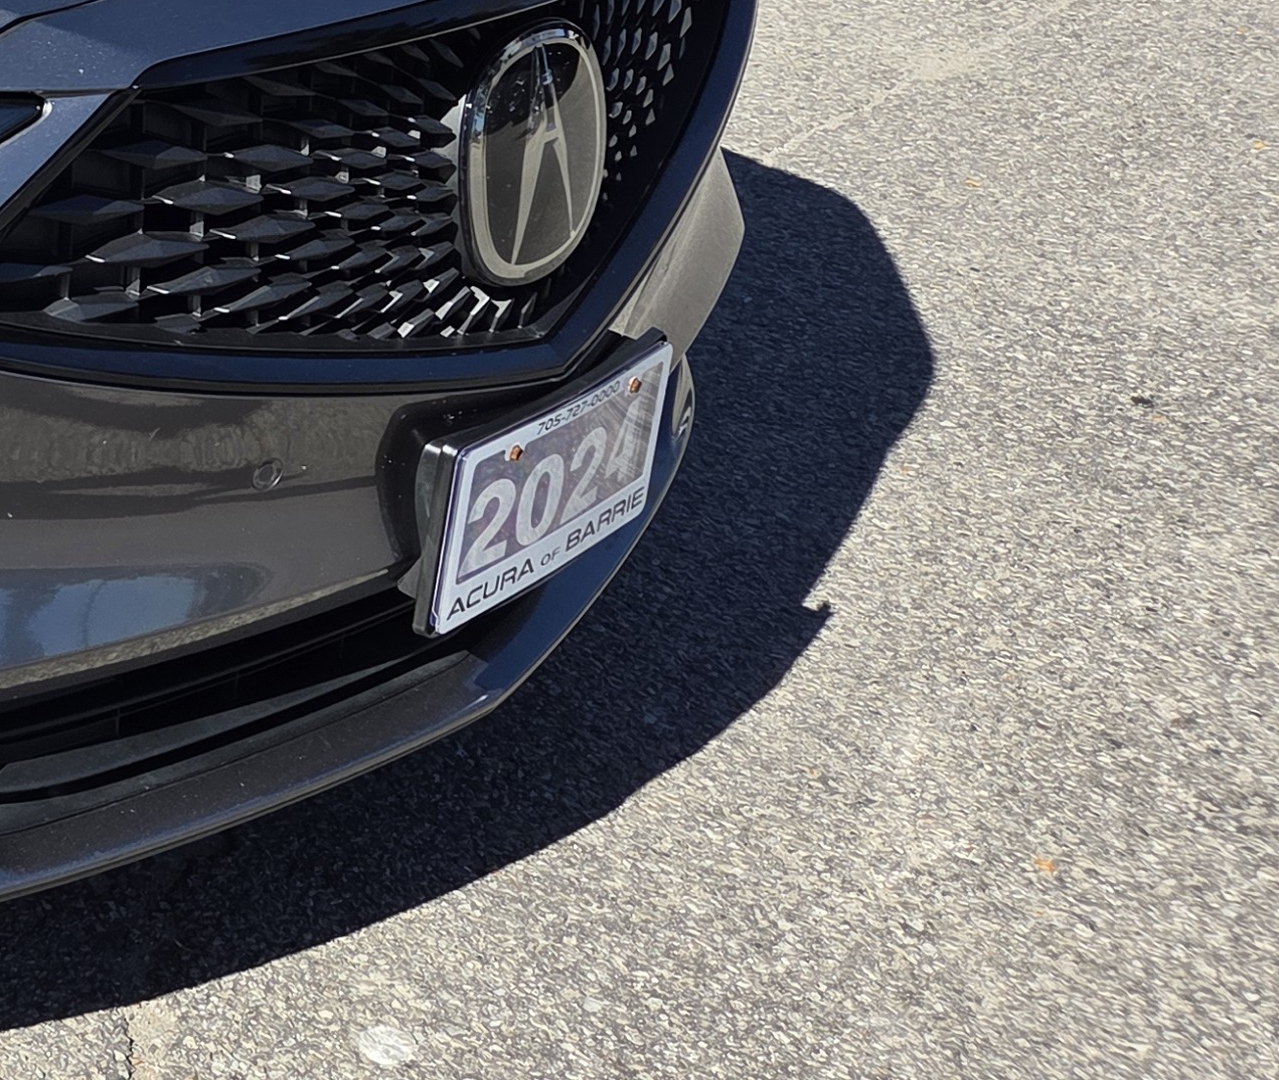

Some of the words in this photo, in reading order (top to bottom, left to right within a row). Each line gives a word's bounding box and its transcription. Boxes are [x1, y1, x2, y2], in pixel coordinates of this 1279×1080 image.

[536, 380, 621, 436] 705-727-0000
[446, 558, 535, 620] ACURA
[565, 486, 645, 552] BARRIE
[457, 395, 642, 577] 2024
